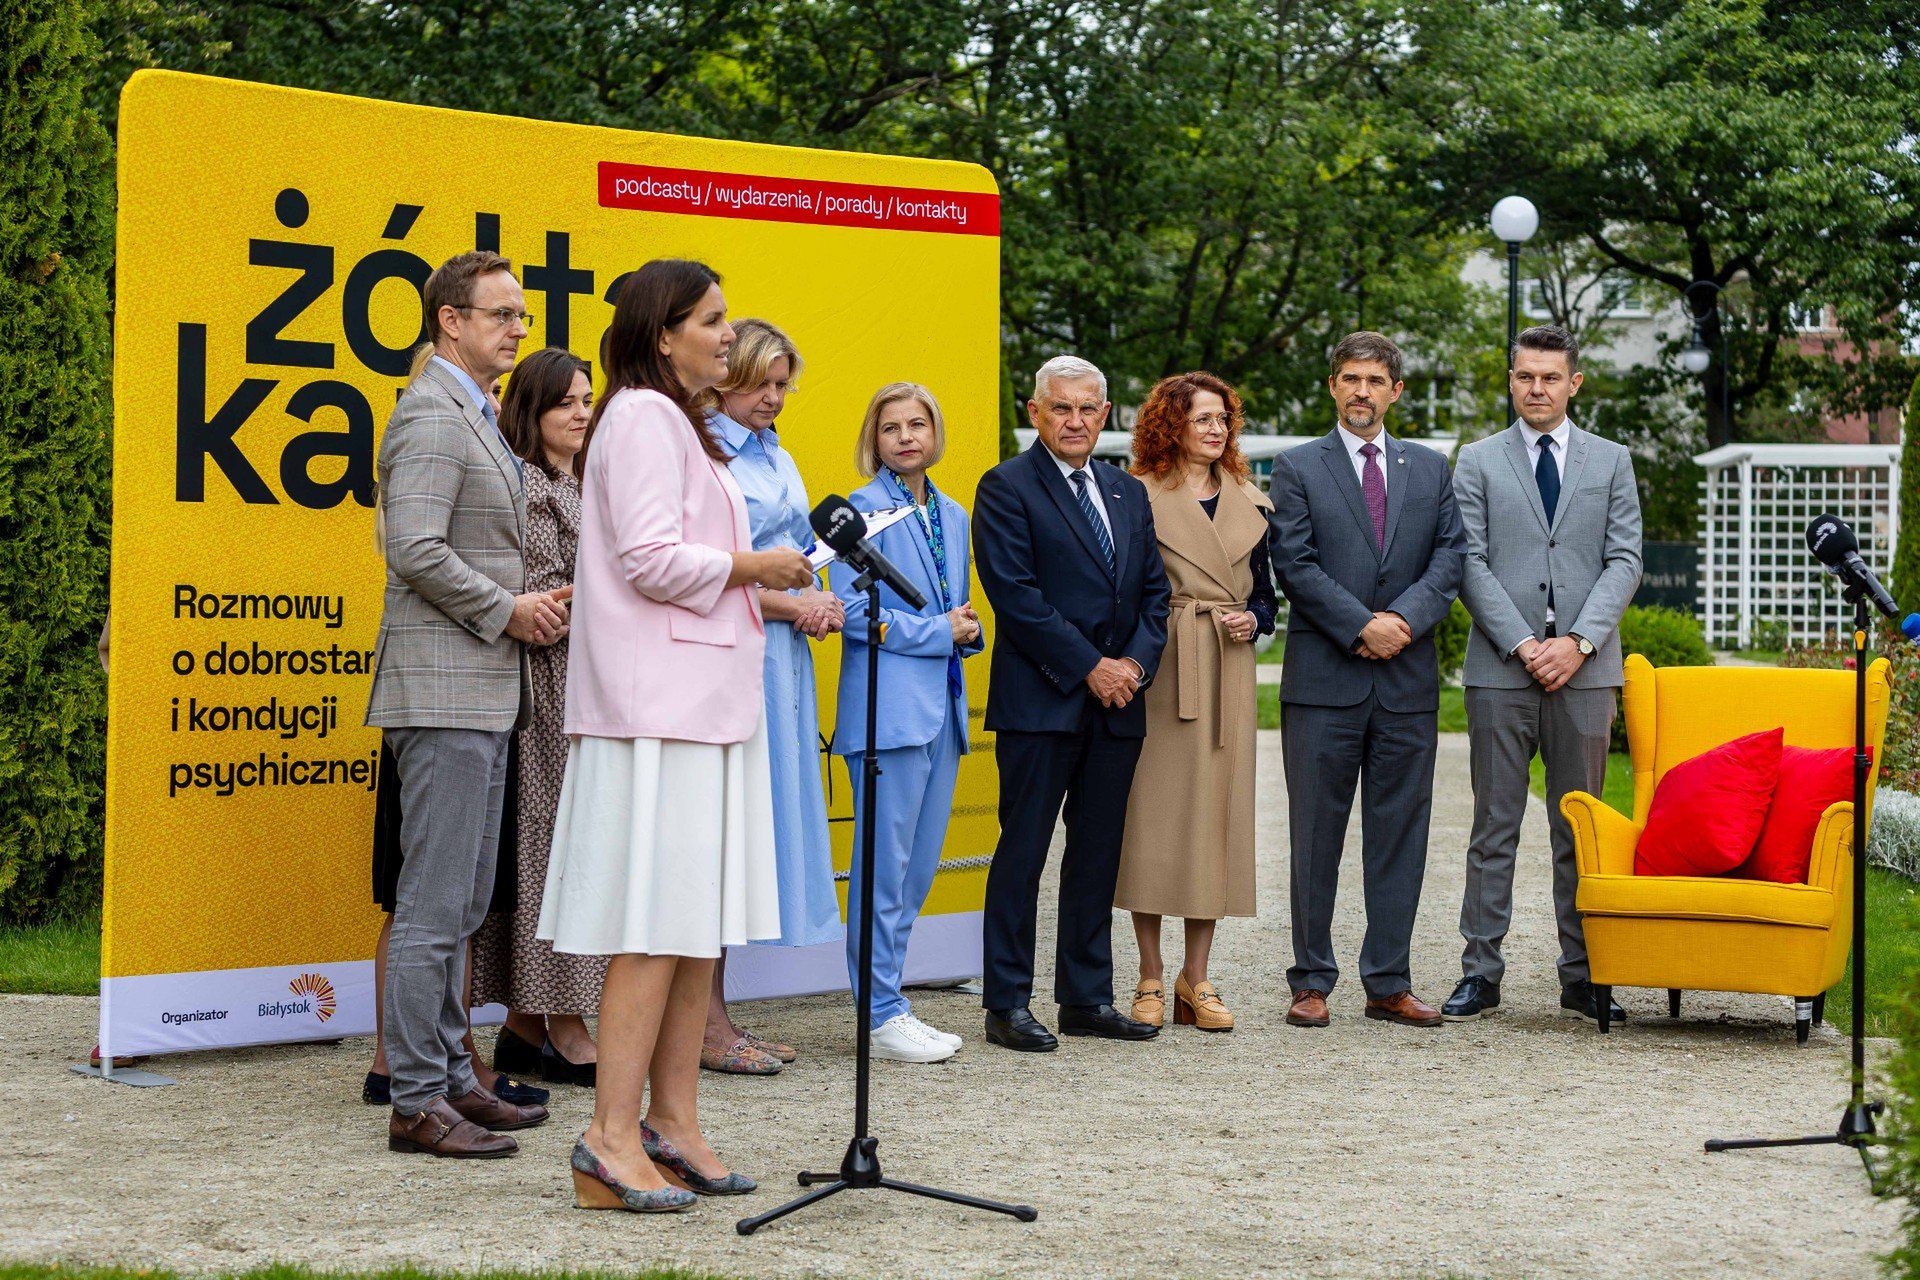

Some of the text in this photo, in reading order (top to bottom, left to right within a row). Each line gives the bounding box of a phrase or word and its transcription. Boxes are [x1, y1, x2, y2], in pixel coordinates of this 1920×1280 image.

[615, 176, 701, 206] podcasty
[715, 187, 812, 209] wydarzenia
[825, 195, 883, 219] porady
[896, 197, 967, 224] kontakty
[174, 584, 343, 629] Rozmowy
[172, 650, 195, 676] o
[171, 695, 337, 739] i kondycji
[169, 749, 379, 798] psychicznej
[161, 1008, 229, 1026] Organizator
[258, 999, 311, 1018] Białystok
